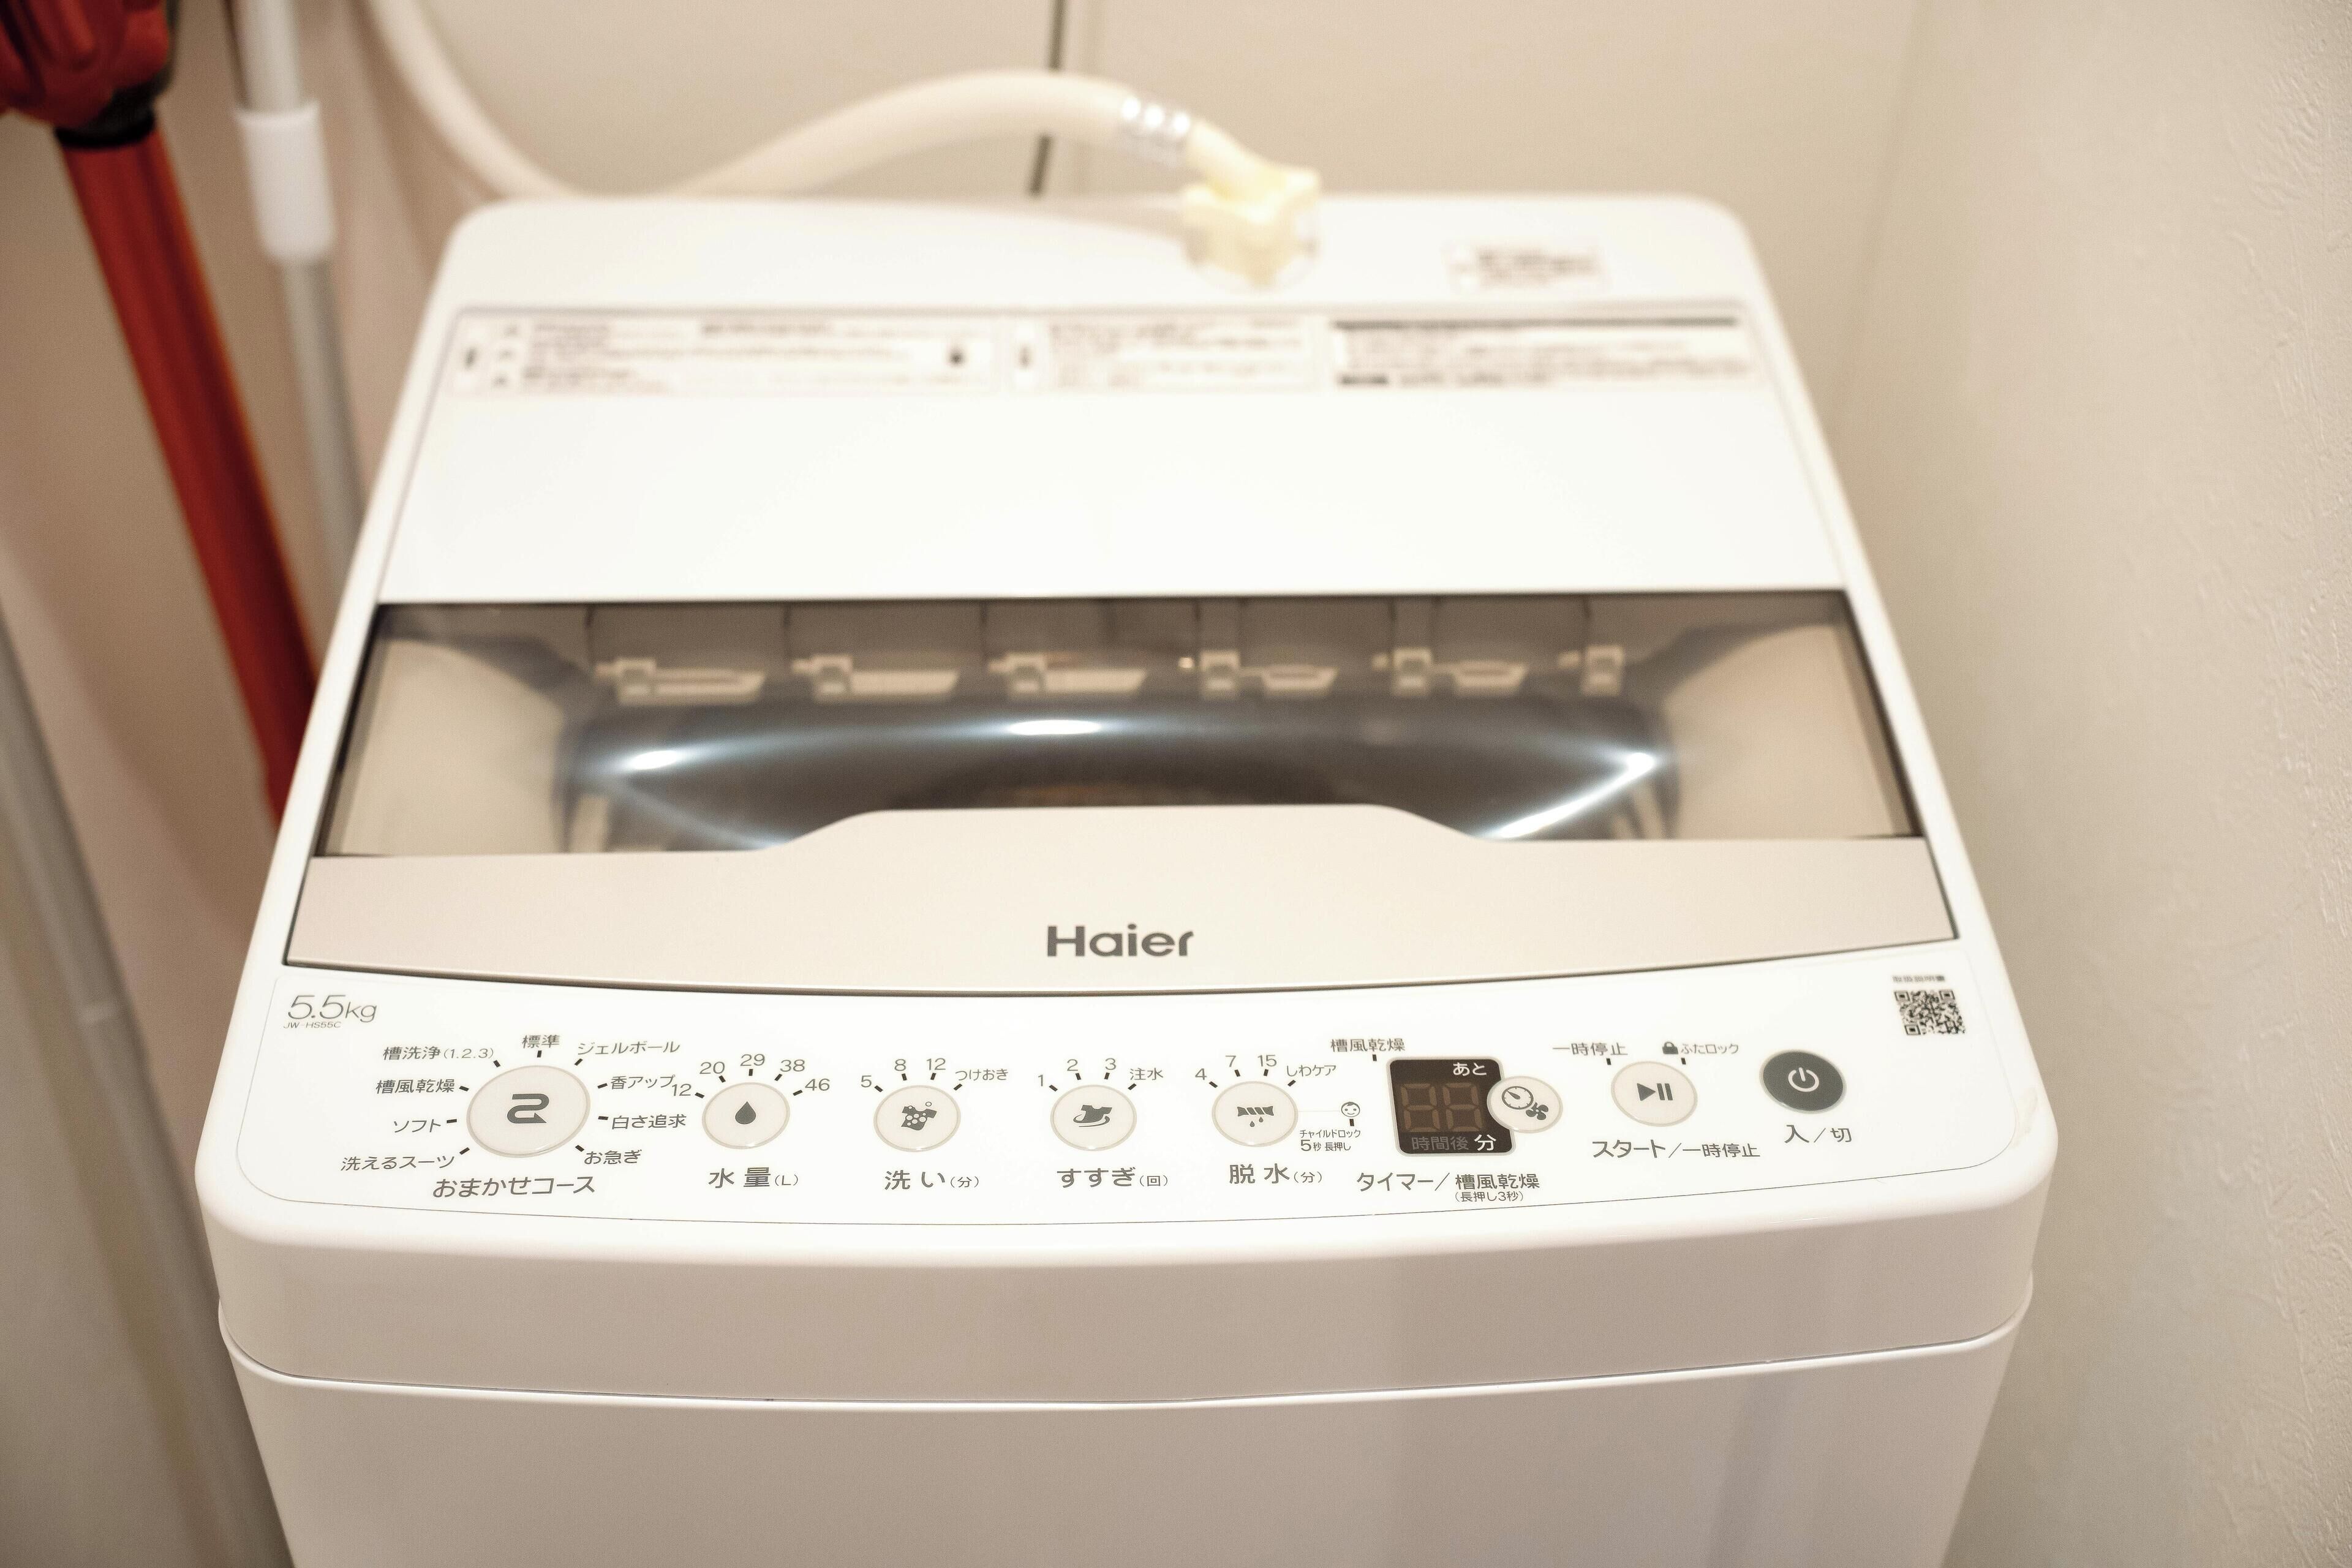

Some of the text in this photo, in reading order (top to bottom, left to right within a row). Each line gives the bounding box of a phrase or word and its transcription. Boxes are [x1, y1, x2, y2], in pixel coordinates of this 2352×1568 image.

[1047, 923, 1194, 957] Haier
[287, 994, 377, 1023] 5.5kg
[521, 1034, 560, 1049] 標準
[578, 1041, 680, 1055] ジェルボール
[1330, 1038, 1406, 1052] 槽風乾燥
[1552, 1042, 1628, 1057] 一時停止
[1680, 1043, 1739, 1055] ふたロック
[739, 1053, 766, 1067] 29
[780, 1059, 805, 1072] 38
[894, 1058, 907, 1072] 8
[926, 1057, 946, 1071] 12
[1066, 1058, 1079, 1072] 2
[1105, 1058, 1117, 1071] 3
[1225, 1055, 1237, 1068] 7
[1257, 1054, 1277, 1067] 15
[699, 1061, 725, 1075] 20
[955, 1068, 1009, 1081] つけおき
[1129, 1067, 1164, 1081] 注水
[1194, 1068, 1207, 1080] 4
[1286, 1064, 1336, 1077] しわケア
[1453, 1061, 1487, 1077] あと
[375, 1079, 455, 1095] 槽風乾燥
[610, 1074, 675, 1090] 香アップ
[805, 1078, 831, 1091] 46
[861, 1075, 872, 1088] 5
[1038, 1074, 1044, 1087] 1
[673, 1083, 692, 1096] 12
[393, 1118, 442, 1133] ソフト
[611, 1114, 687, 1130] 白さ追求
[1299, 1129, 1361, 1139] チャイルドロック
[1411, 1136, 1469, 1152] 時間後
[1474, 1134, 1497, 1152] 分
[340, 1155, 455, 1171] 洗えるスーツ
[584, 1149, 643, 1165] お急ぎ
[432, 1176, 595, 1198] おまかせコース
[1455, 1191, 1523, 1202] (長押し3秒)
